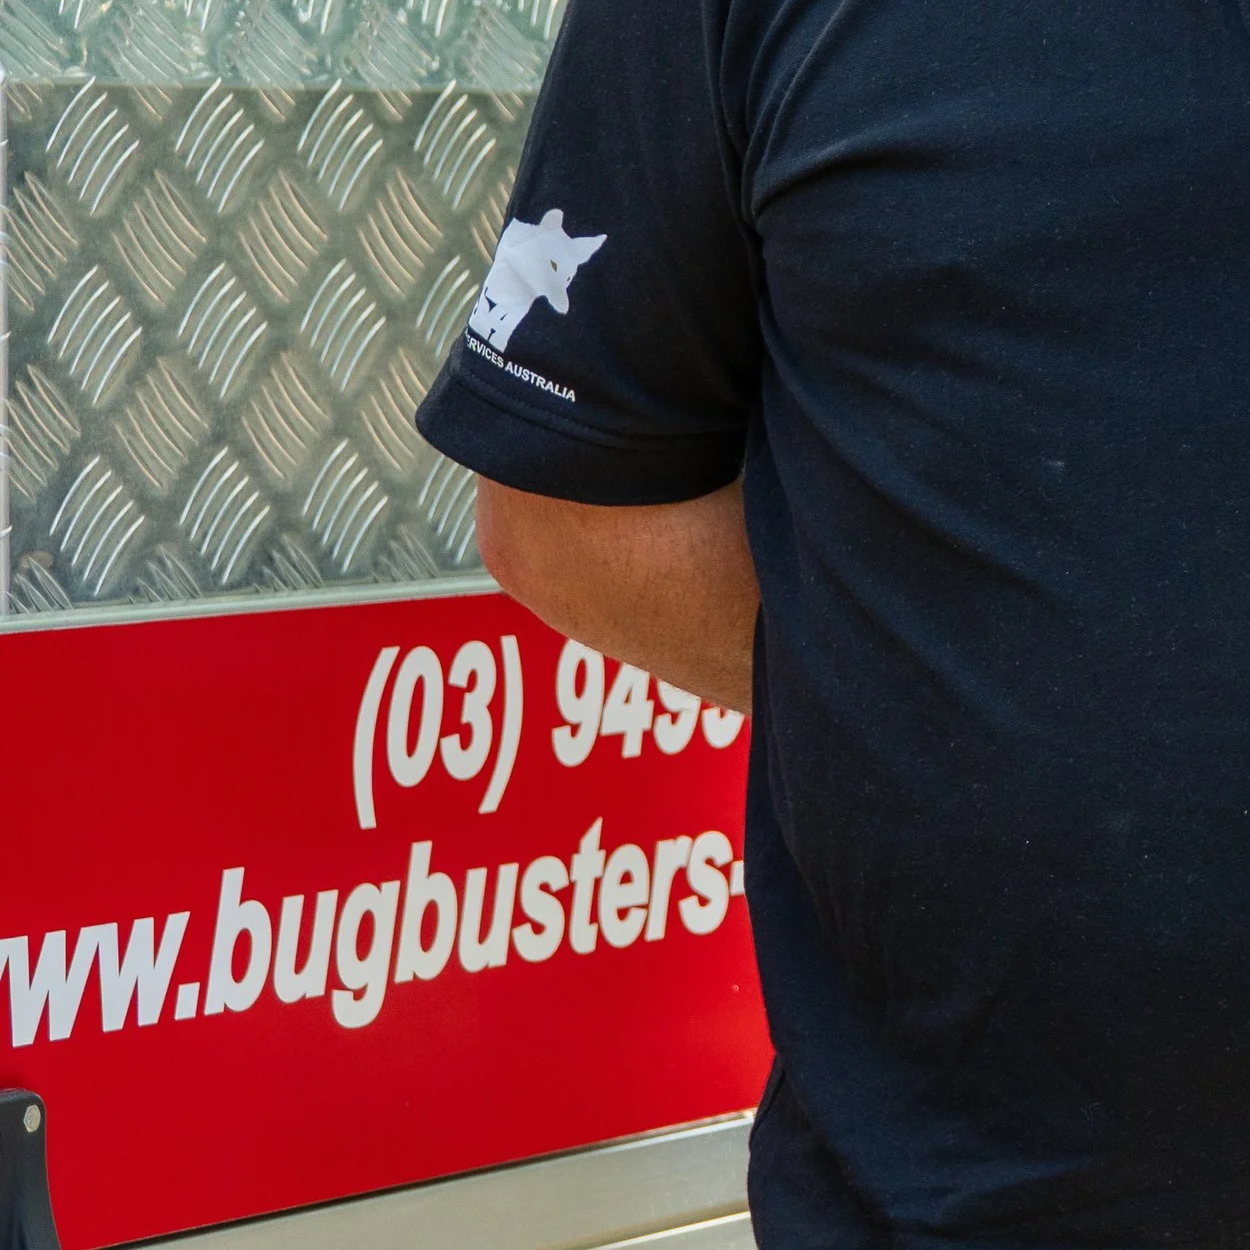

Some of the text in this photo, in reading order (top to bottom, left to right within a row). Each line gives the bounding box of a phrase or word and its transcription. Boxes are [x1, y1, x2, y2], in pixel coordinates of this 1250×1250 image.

[464, 332, 576, 402] ERVICES AUSTRALIA
[353, 634, 524, 830] (03)
[0, 816, 746, 1048] ww.bugbusters-
